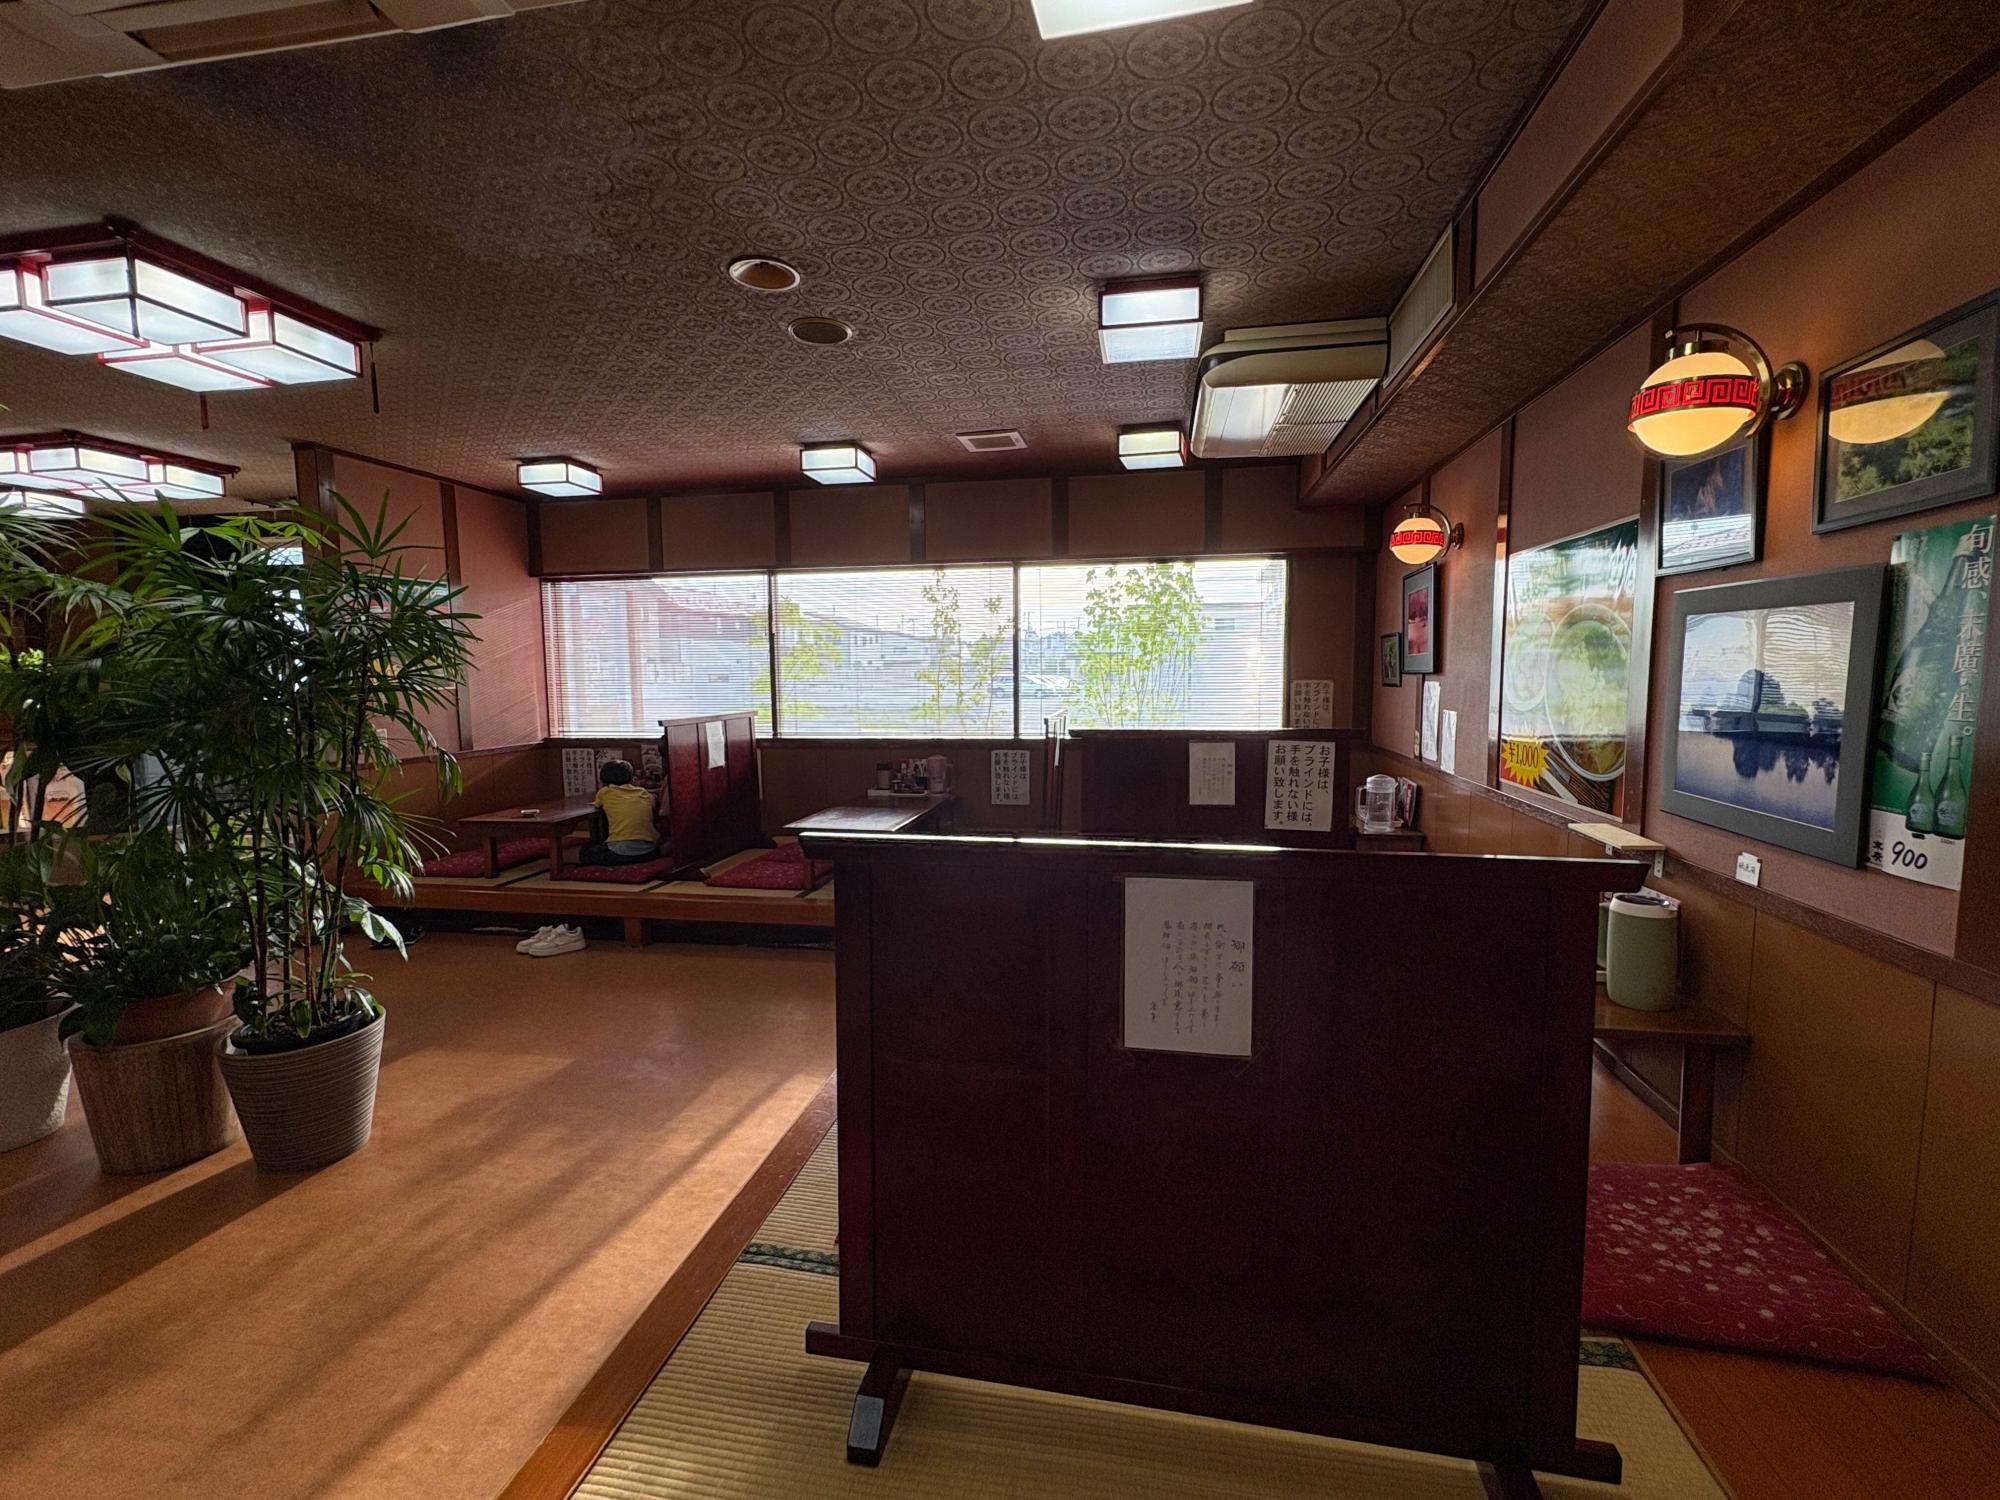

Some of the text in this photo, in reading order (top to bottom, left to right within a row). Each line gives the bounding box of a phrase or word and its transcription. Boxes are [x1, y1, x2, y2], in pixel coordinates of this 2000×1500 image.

[1272, 744, 1287, 825] お願い致します。
[1287, 744, 1301, 822] 手を触れない様
[1302, 745, 1316, 826] ブラインドには、
[1317, 746, 1330, 794] お子様は、
[1891, 840, 1928, 869] 900
